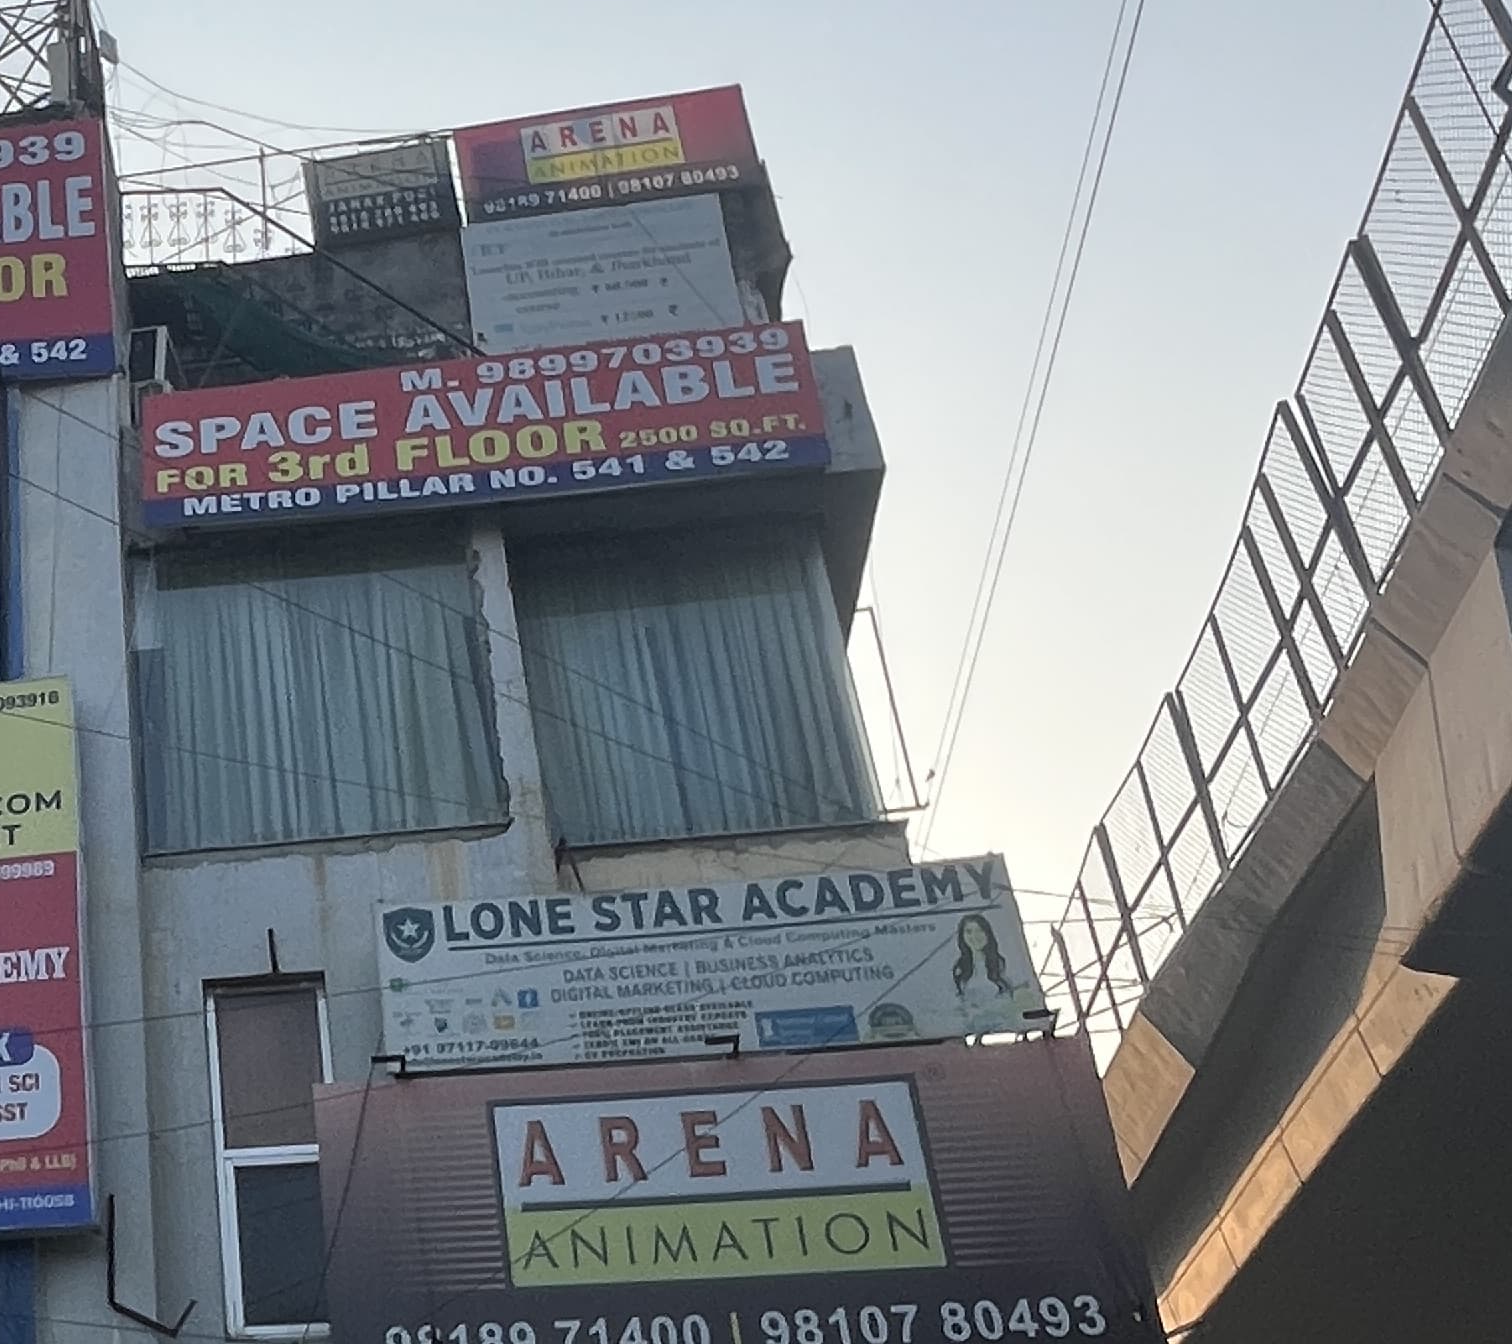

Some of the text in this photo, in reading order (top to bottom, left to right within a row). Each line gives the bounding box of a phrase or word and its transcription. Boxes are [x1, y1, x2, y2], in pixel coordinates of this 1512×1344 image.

[529, 111, 671, 154] ARENA
[532, 146, 680, 178] ANIMATION
[545, 184, 602, 203] 71400
[0, 344, 19, 365] &
[32, 339, 87, 363] 542
[401, 327, 787, 393] M. 9899703939
[155, 353, 799, 457] SPACE AVAILABLE
[156, 413, 806, 494] FOR 3rd FLOOR 2500 SQ.FT.
[183, 438, 789, 516] METRO PILLAR NO. 541 & 542
[442, 862, 994, 942] LONE STAR ACADEMY
[551, 965, 894, 1003] DIGITAL MARKETING CLOUD COMPUTING
[563, 947, 874, 984] DATA SCIENCE BUSINESS ANALYTICS
[8, 1073, 40, 1093] SCI
[518, 1099, 905, 1188] ARENA
[520, 1208, 932, 1271] ANIMATION
[940, 1295, 1107, 1342] 80493
